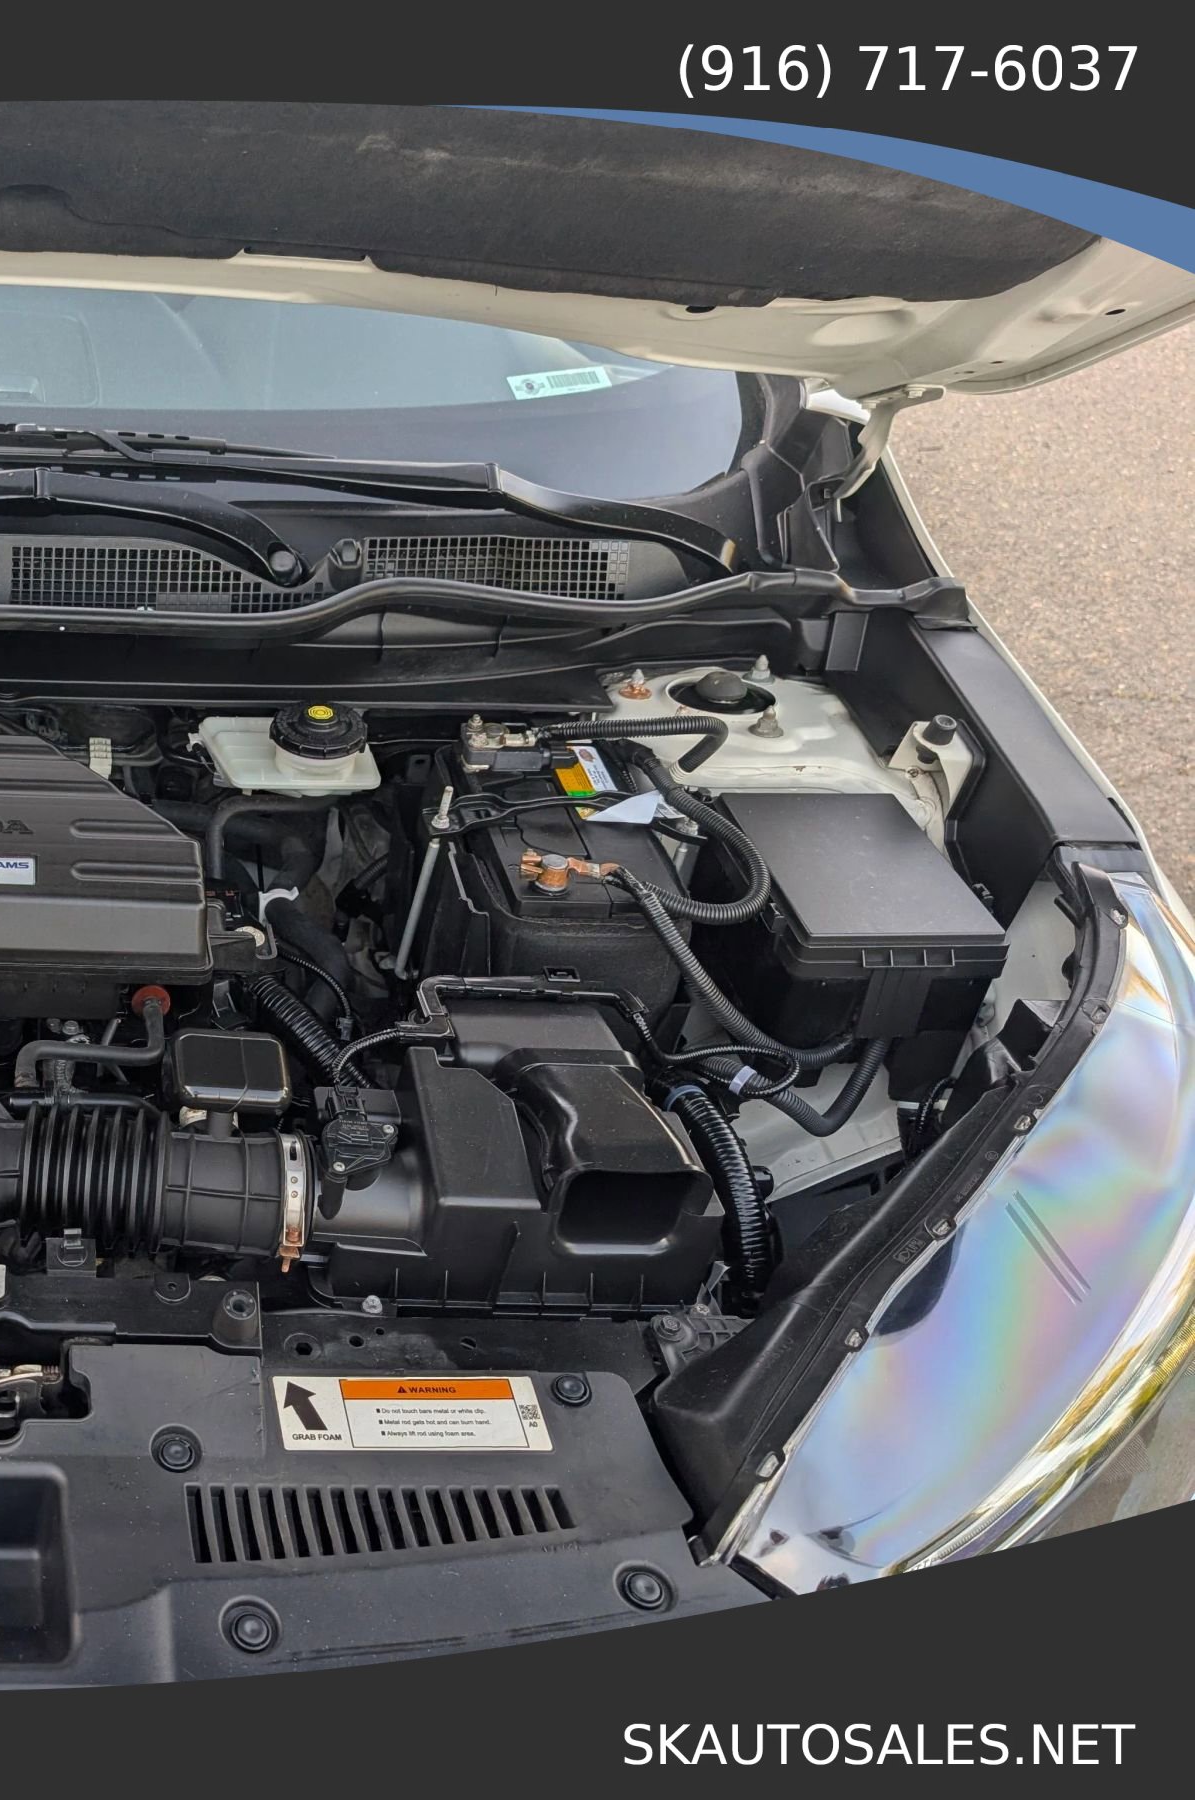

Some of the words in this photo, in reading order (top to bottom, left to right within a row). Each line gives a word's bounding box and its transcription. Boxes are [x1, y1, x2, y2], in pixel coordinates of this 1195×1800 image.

[409, 1386, 457, 1394] WARNING
[291, 1433, 317, 1441] GRAB
[317, 1433, 343, 1441] FOAM
